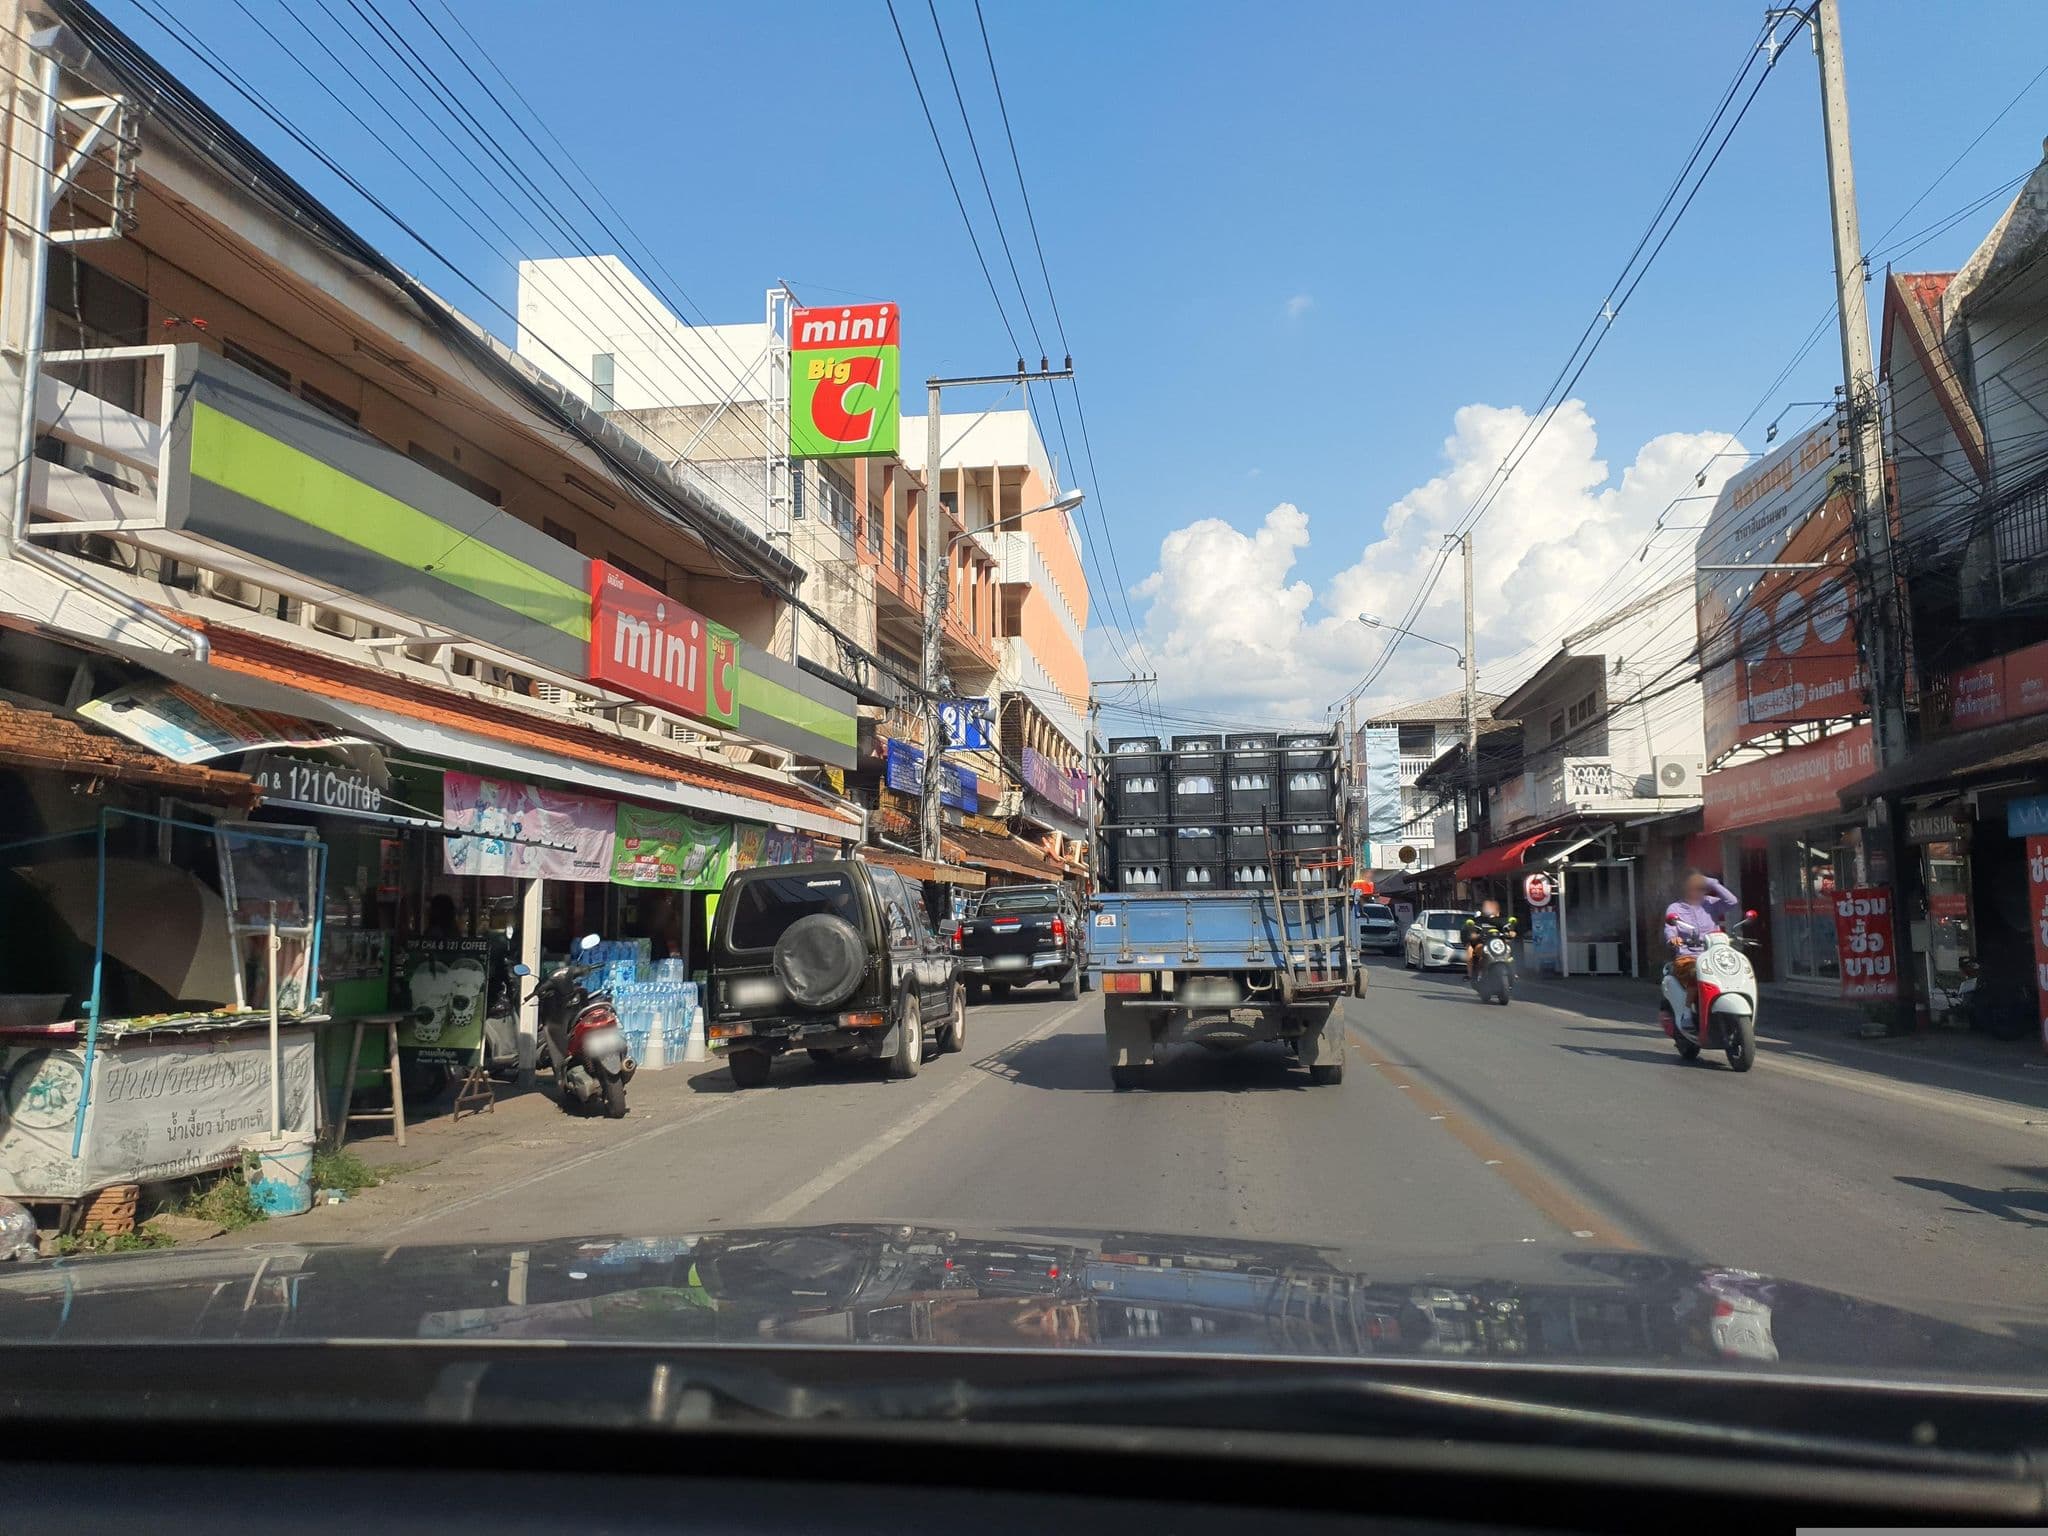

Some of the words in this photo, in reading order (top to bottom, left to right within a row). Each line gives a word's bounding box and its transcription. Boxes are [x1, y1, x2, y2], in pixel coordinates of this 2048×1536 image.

[801, 307, 888, 342] mini
[808, 358, 852, 384] Big
[811, 356, 883, 443] C
[614, 603, 699, 692] mini
[712, 635, 727, 660] Big
[713, 638, 737, 717] C
[274, 772, 282, 790] &
[290, 766, 320, 802] 121
[324, 771, 382, 811] Coffee
[1909, 815, 1958, 837] SAMSUN
[1837, 892, 1887, 917] ซ่อม
[461, 941, 488, 951] COFFEE
[1849, 918, 1884, 953] ซื้อ
[1844, 955, 1891, 977] ขาย
[167, 1108, 213, 1142] น้ำเงี้ยว
[217, 1108, 264, 1133] น้ำยากะทิ
